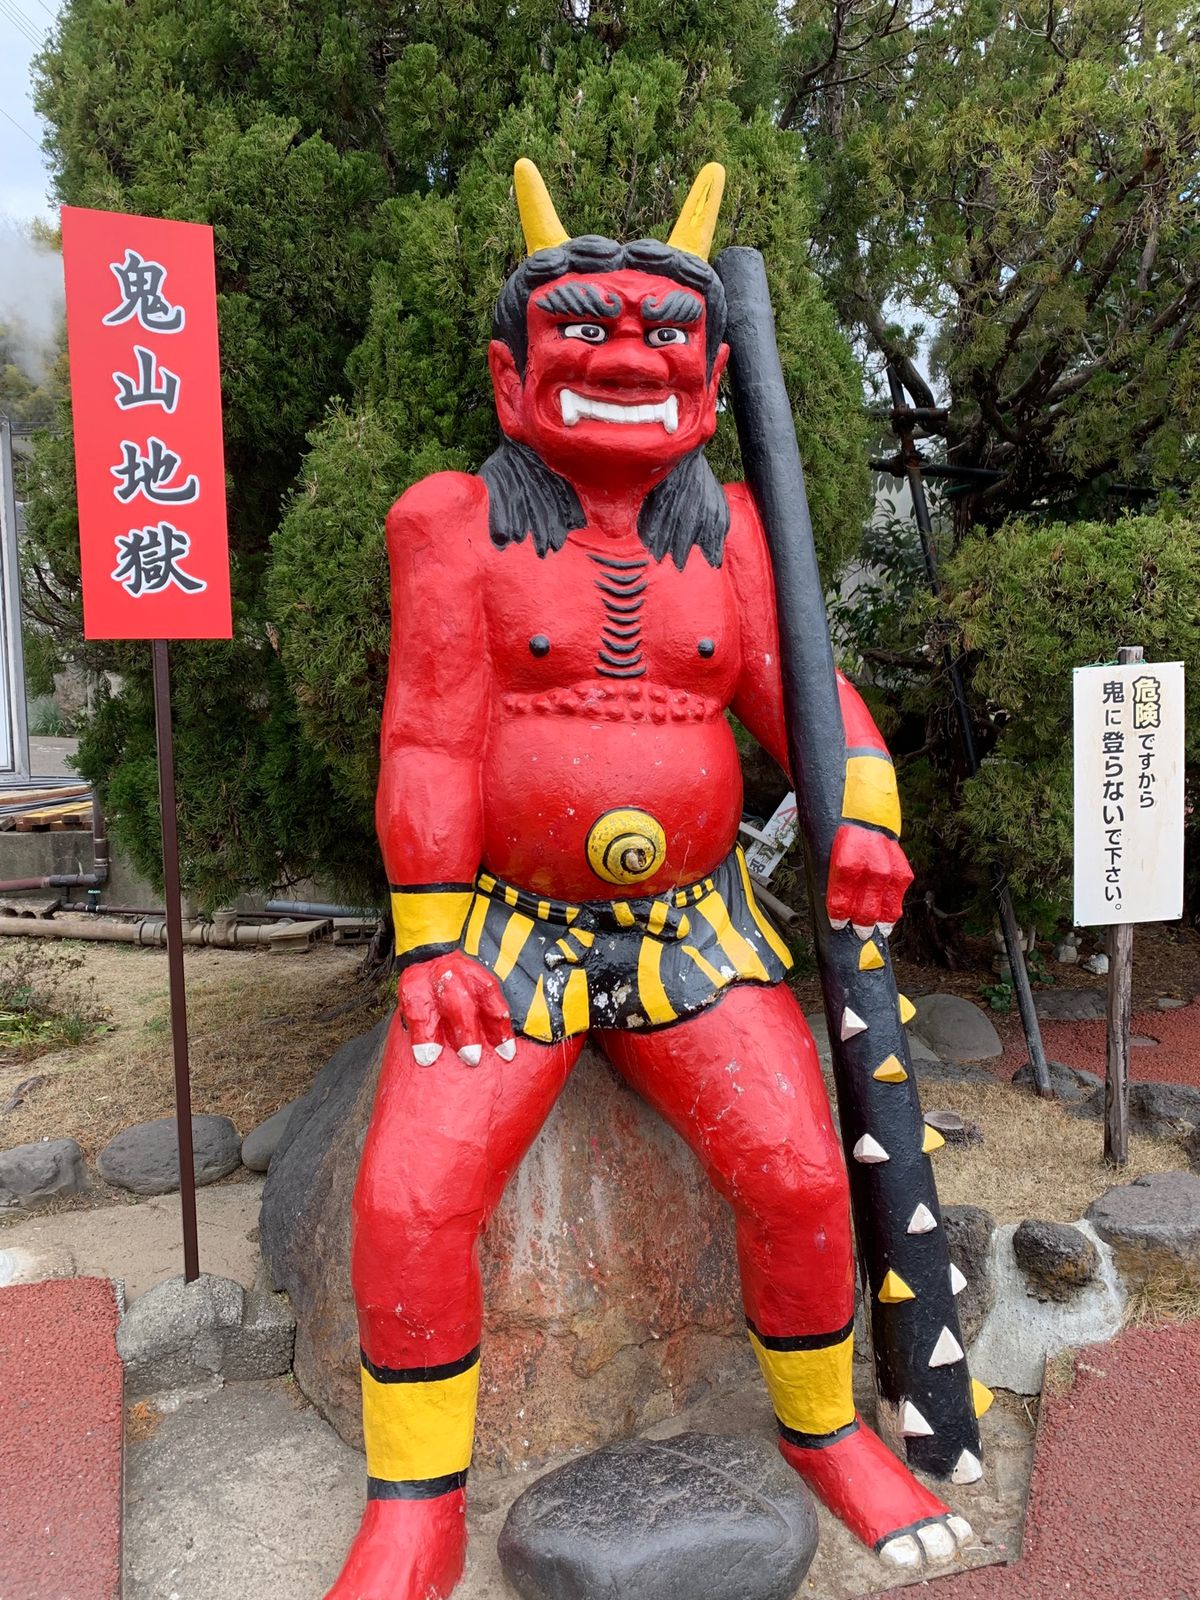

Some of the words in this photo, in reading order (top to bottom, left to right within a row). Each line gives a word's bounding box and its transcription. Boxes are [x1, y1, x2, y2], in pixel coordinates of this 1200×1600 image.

[102, 249, 207, 597] 鬼山地獄
[1102, 680, 1125, 911] 鬼に登らないで下さい。
[1132, 676, 1160, 809] 危険ですから
